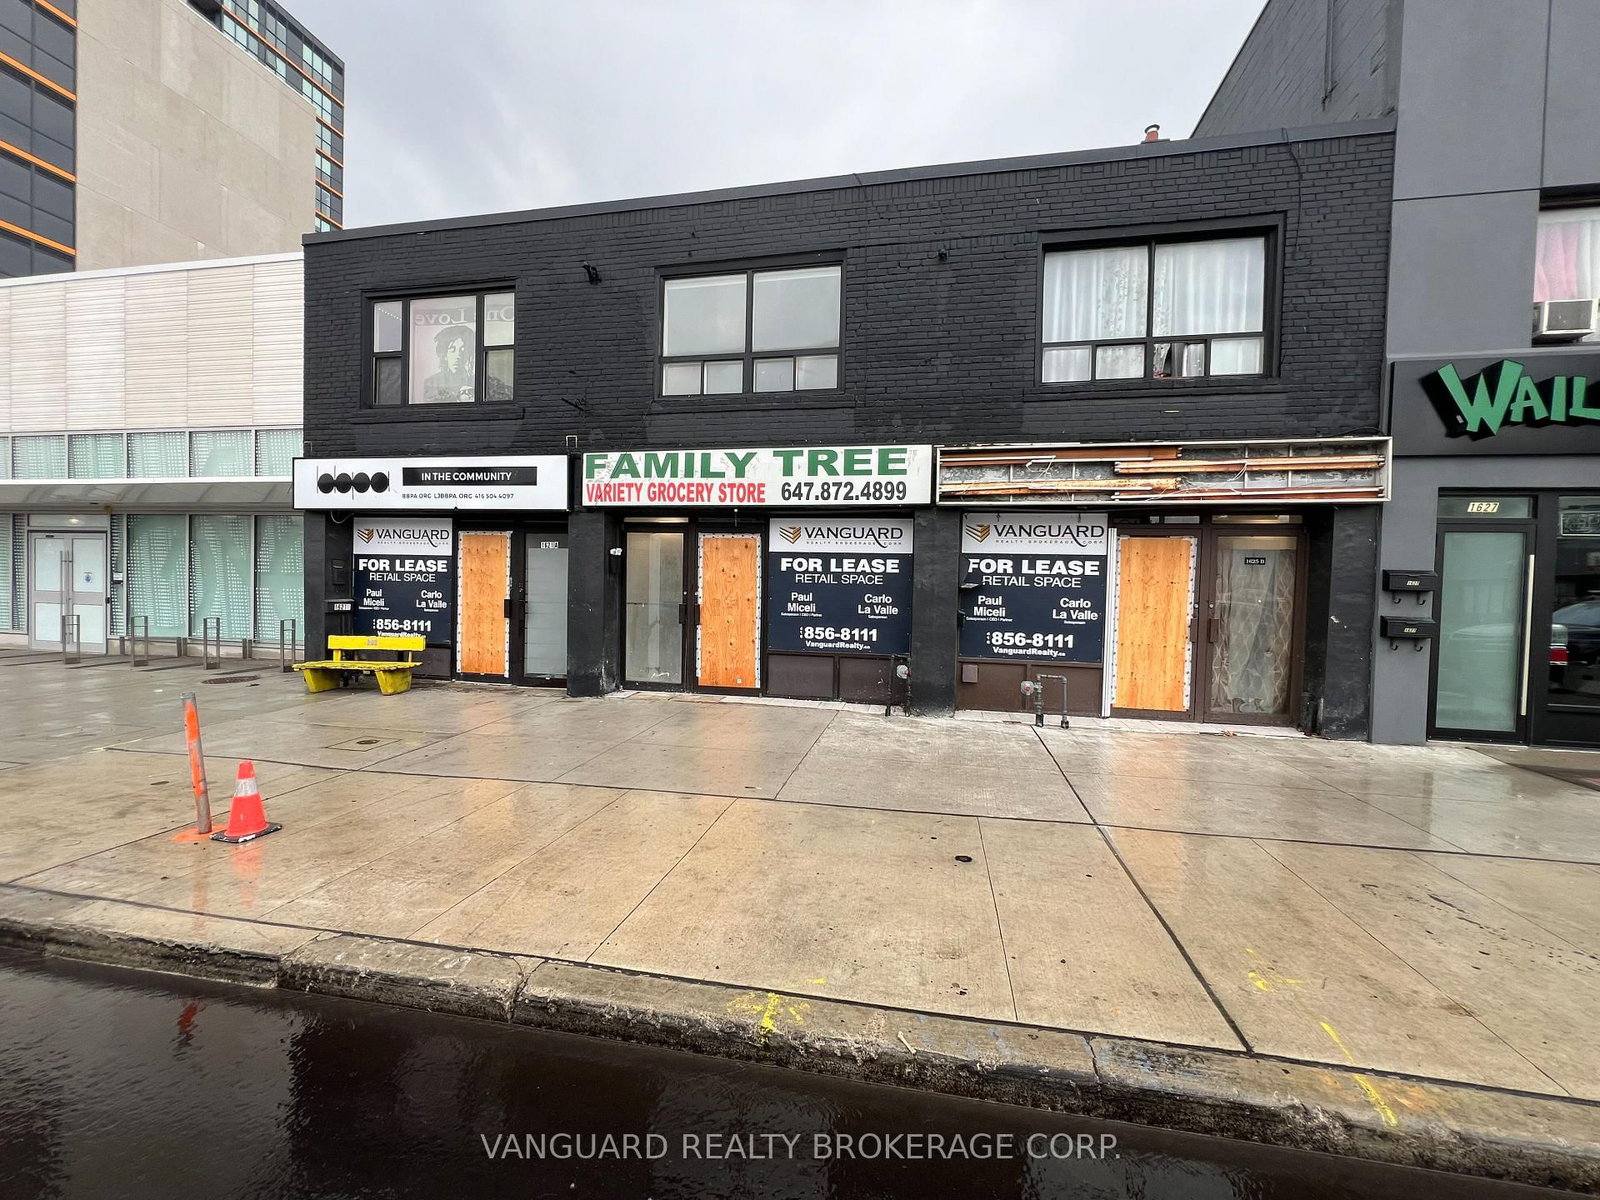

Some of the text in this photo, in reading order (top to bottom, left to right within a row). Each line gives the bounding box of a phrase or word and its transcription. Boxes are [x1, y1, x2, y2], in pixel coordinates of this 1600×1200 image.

[585, 448, 908, 480] FAMILY TREE
[422, 472, 512, 482] IN THE COMMUNITY
[586, 482, 766, 503] VARIETY GROCERY STORE
[781, 481, 907, 501] 647.872.4899
[1470, 502, 1498, 512] 1627
[376, 529, 450, 547] VANGUARD
[804, 527, 903, 548] VANGUARD
[993, 524, 1104, 547] VANGUARD
[358, 559, 448, 572] FOR LEASE
[780, 558, 900, 573] FOR LEASE
[968, 558, 1100, 576] FOR LEASE
[370, 572, 436, 582] RETAIL SPACE
[796, 574, 884, 584] RETAIL SPACE
[982, 576, 1082, 588] RETAIL SPACE
[366, 588, 382, 597] Paul
[421, 590, 442, 599] Carlo
[791, 592, 812, 601] Paul
[364, 598, 384, 607] Miceli
[416, 600, 447, 608] La Valle
[864, 594, 892, 604] Carlo
[978, 596, 1002, 605] Paul
[1060, 598, 1091, 608] Carlo
[787, 602, 816, 612] Miceli
[858, 605, 898, 615] La Valle
[973, 606, 1006, 617] Miceli
[1052, 609, 1098, 620] La Valle
[376, 619, 432, 632] 856-8111
[804, 627, 877, 641] 856-8111
[991, 631, 1074, 648] 856-8111
